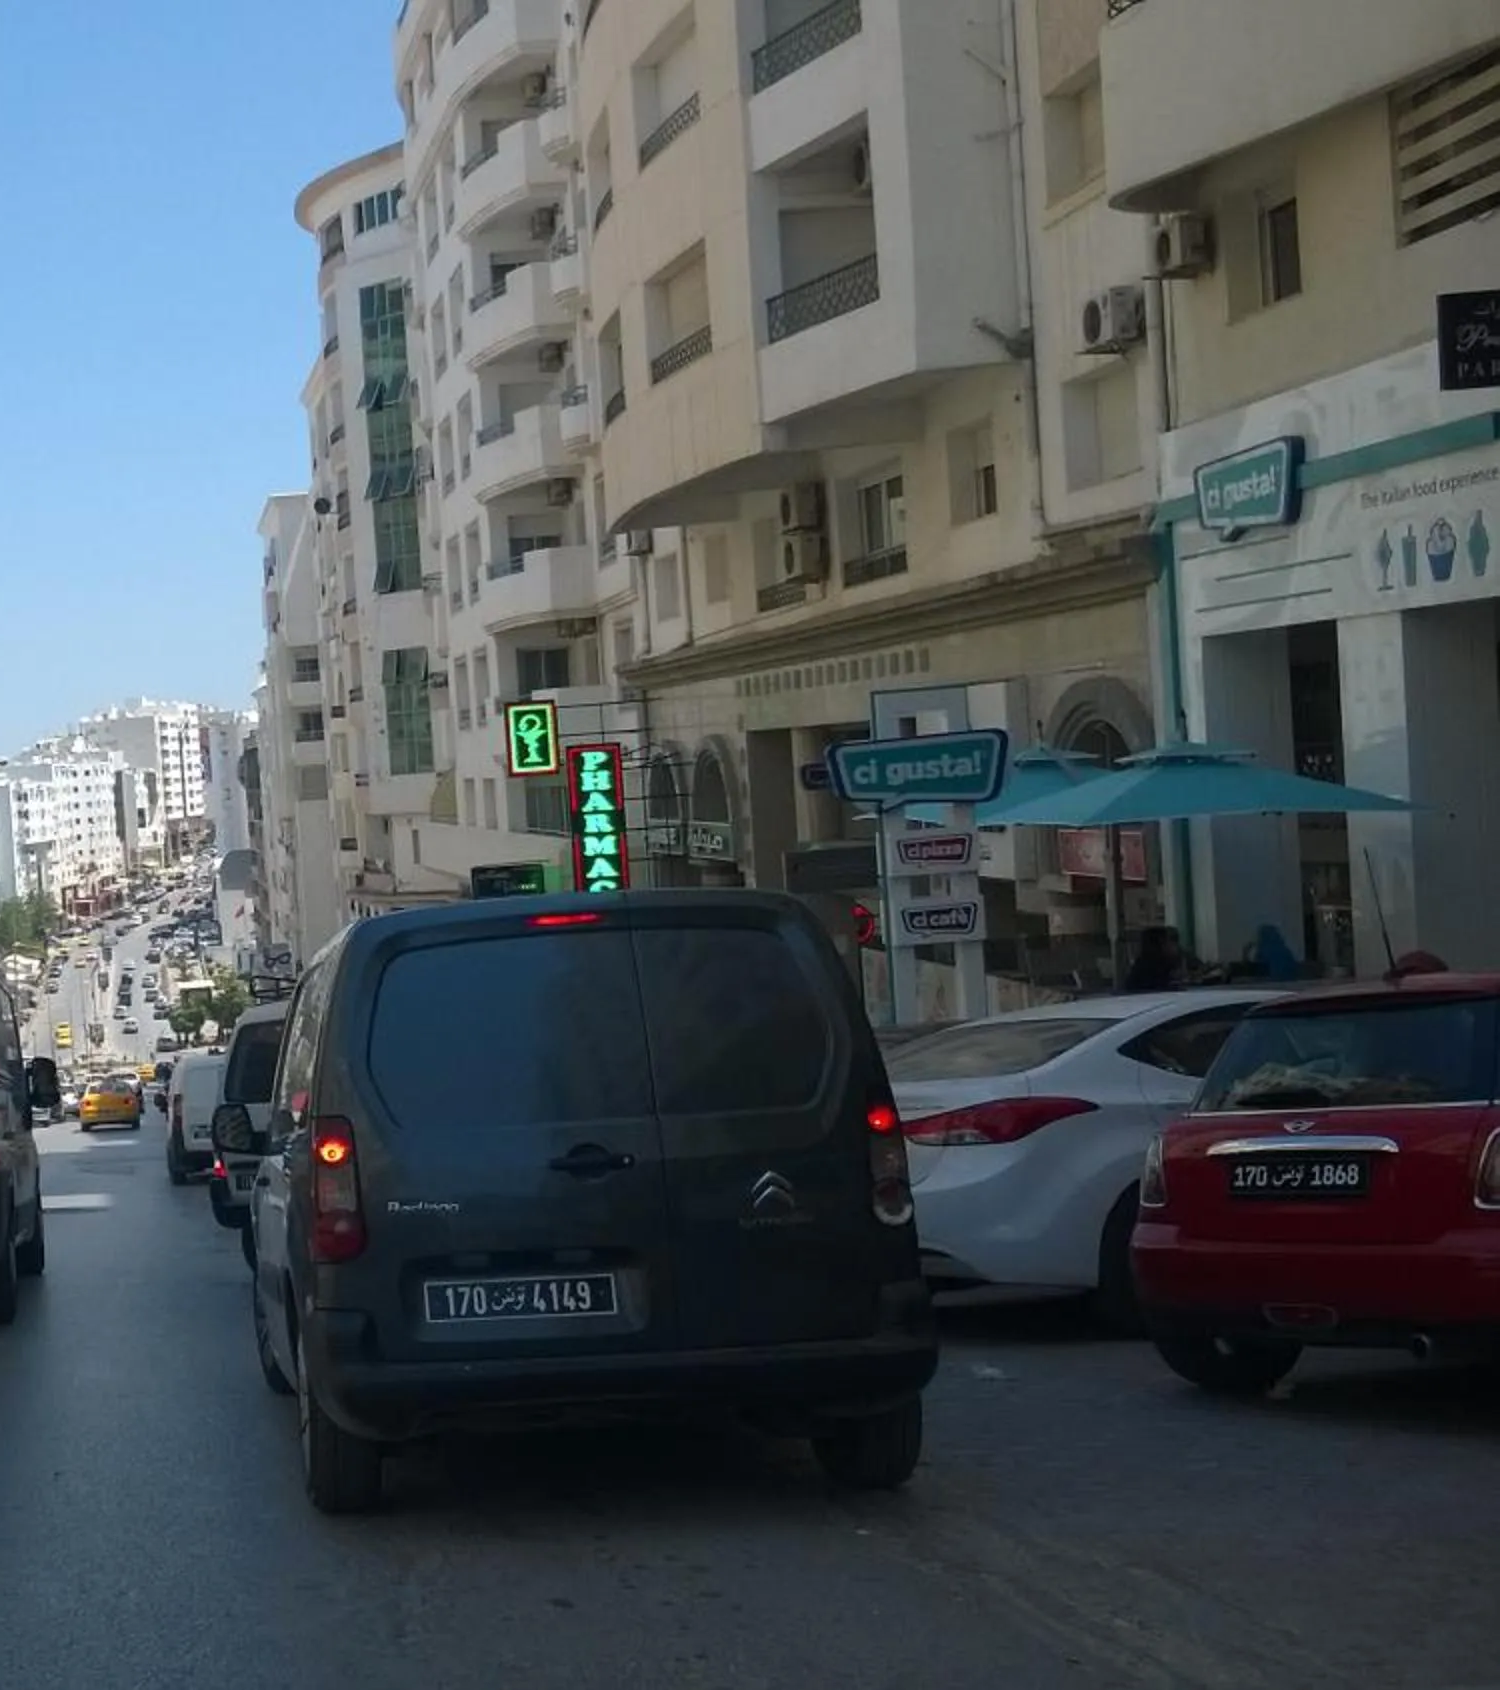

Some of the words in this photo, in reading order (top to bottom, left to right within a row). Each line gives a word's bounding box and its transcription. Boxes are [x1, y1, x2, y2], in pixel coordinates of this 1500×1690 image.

[1207, 481, 1219, 510] ci
[1223, 464, 1276, 511] gusta!
[1360, 491, 1379, 510] The
[1380, 485, 1411, 505] Italian
[1412, 476, 1438, 497] food
[1440, 466, 1499, 496] experience
[853, 758, 877, 785] ci
[885, 751, 982, 785] gusta!
[1233, 1165, 1268, 1187] 170
[1272, 1165, 1305, 1187] تونس
[1310, 1163, 1359, 1185] 1868
[446, 1286, 487, 1317] 170
[491, 1286, 526, 1311] تونس
[532, 1281, 591, 1313] 4149
